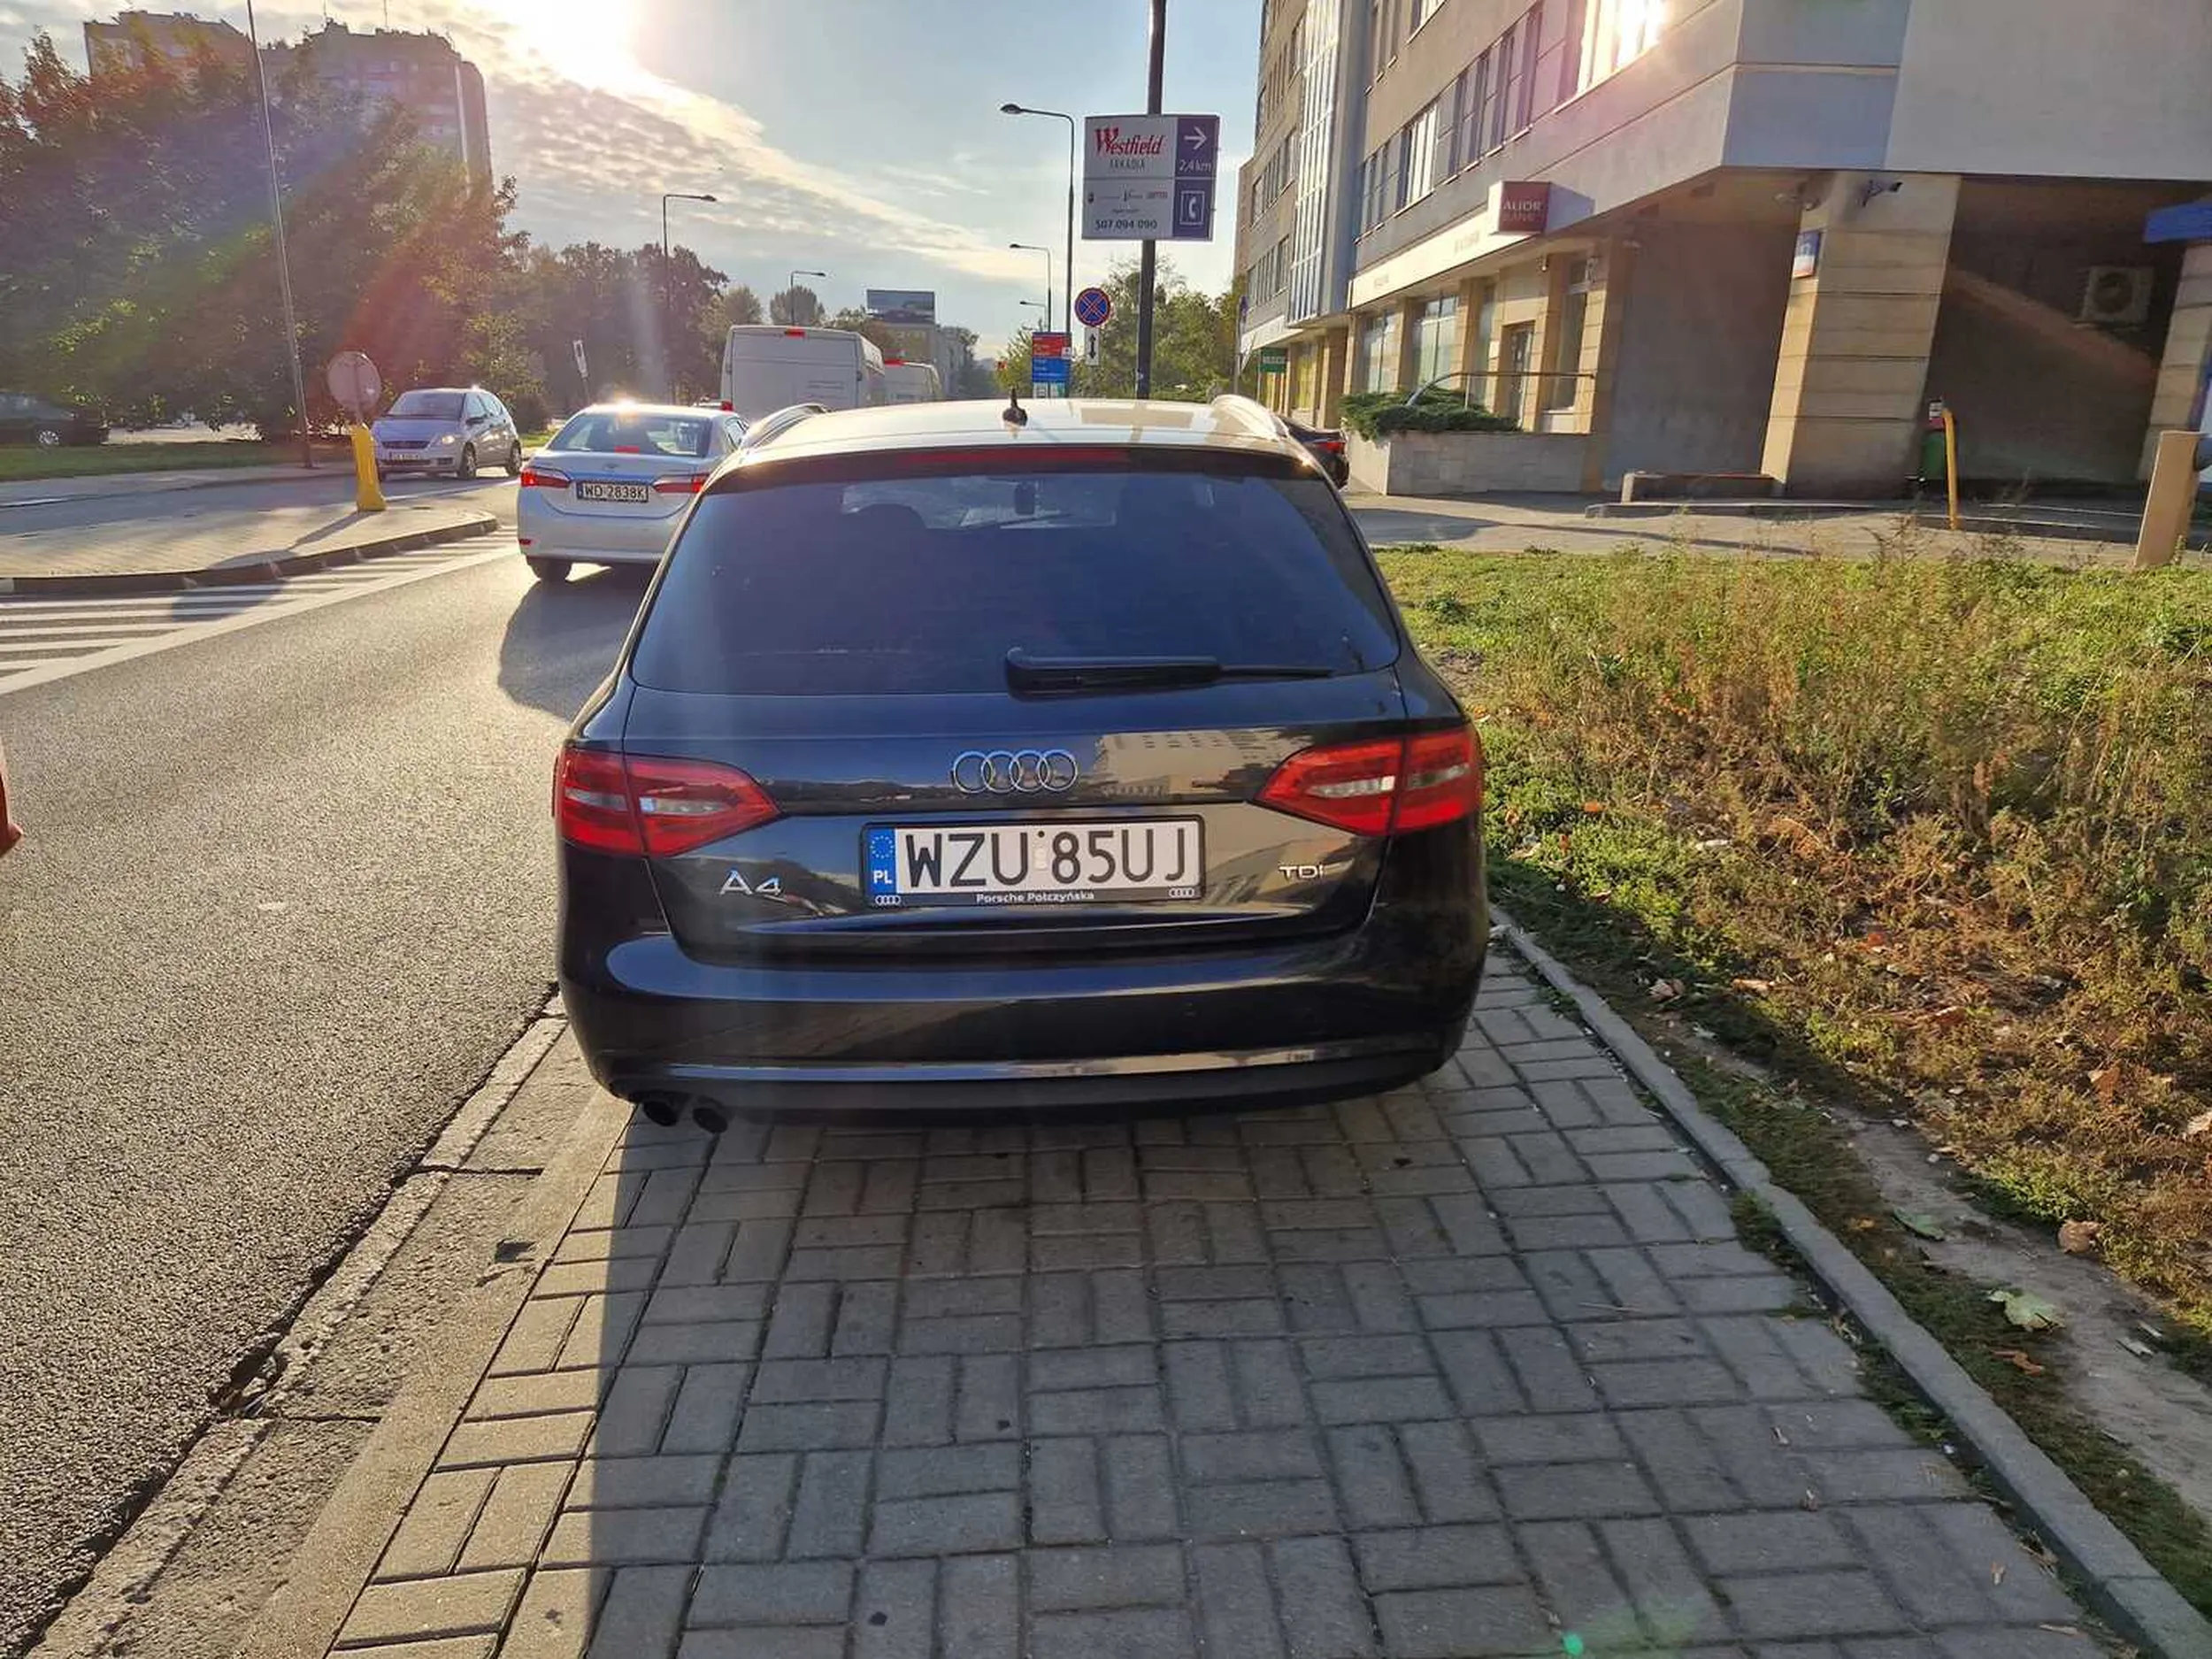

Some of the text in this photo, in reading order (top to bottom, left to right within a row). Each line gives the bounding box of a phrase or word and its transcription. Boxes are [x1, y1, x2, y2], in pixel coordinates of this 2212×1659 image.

[1094, 127, 1164, 155] Westfield
[1502, 200, 1542, 211] ALIOR
[585, 485, 644, 499] WD 2838K
[905, 827, 1186, 887] WZU 85UJ
[872, 870, 893, 885] PL
[1279, 864, 1324, 879] TDI
[719, 869, 781, 895] A4
[976, 893, 1025, 903] Porsche
